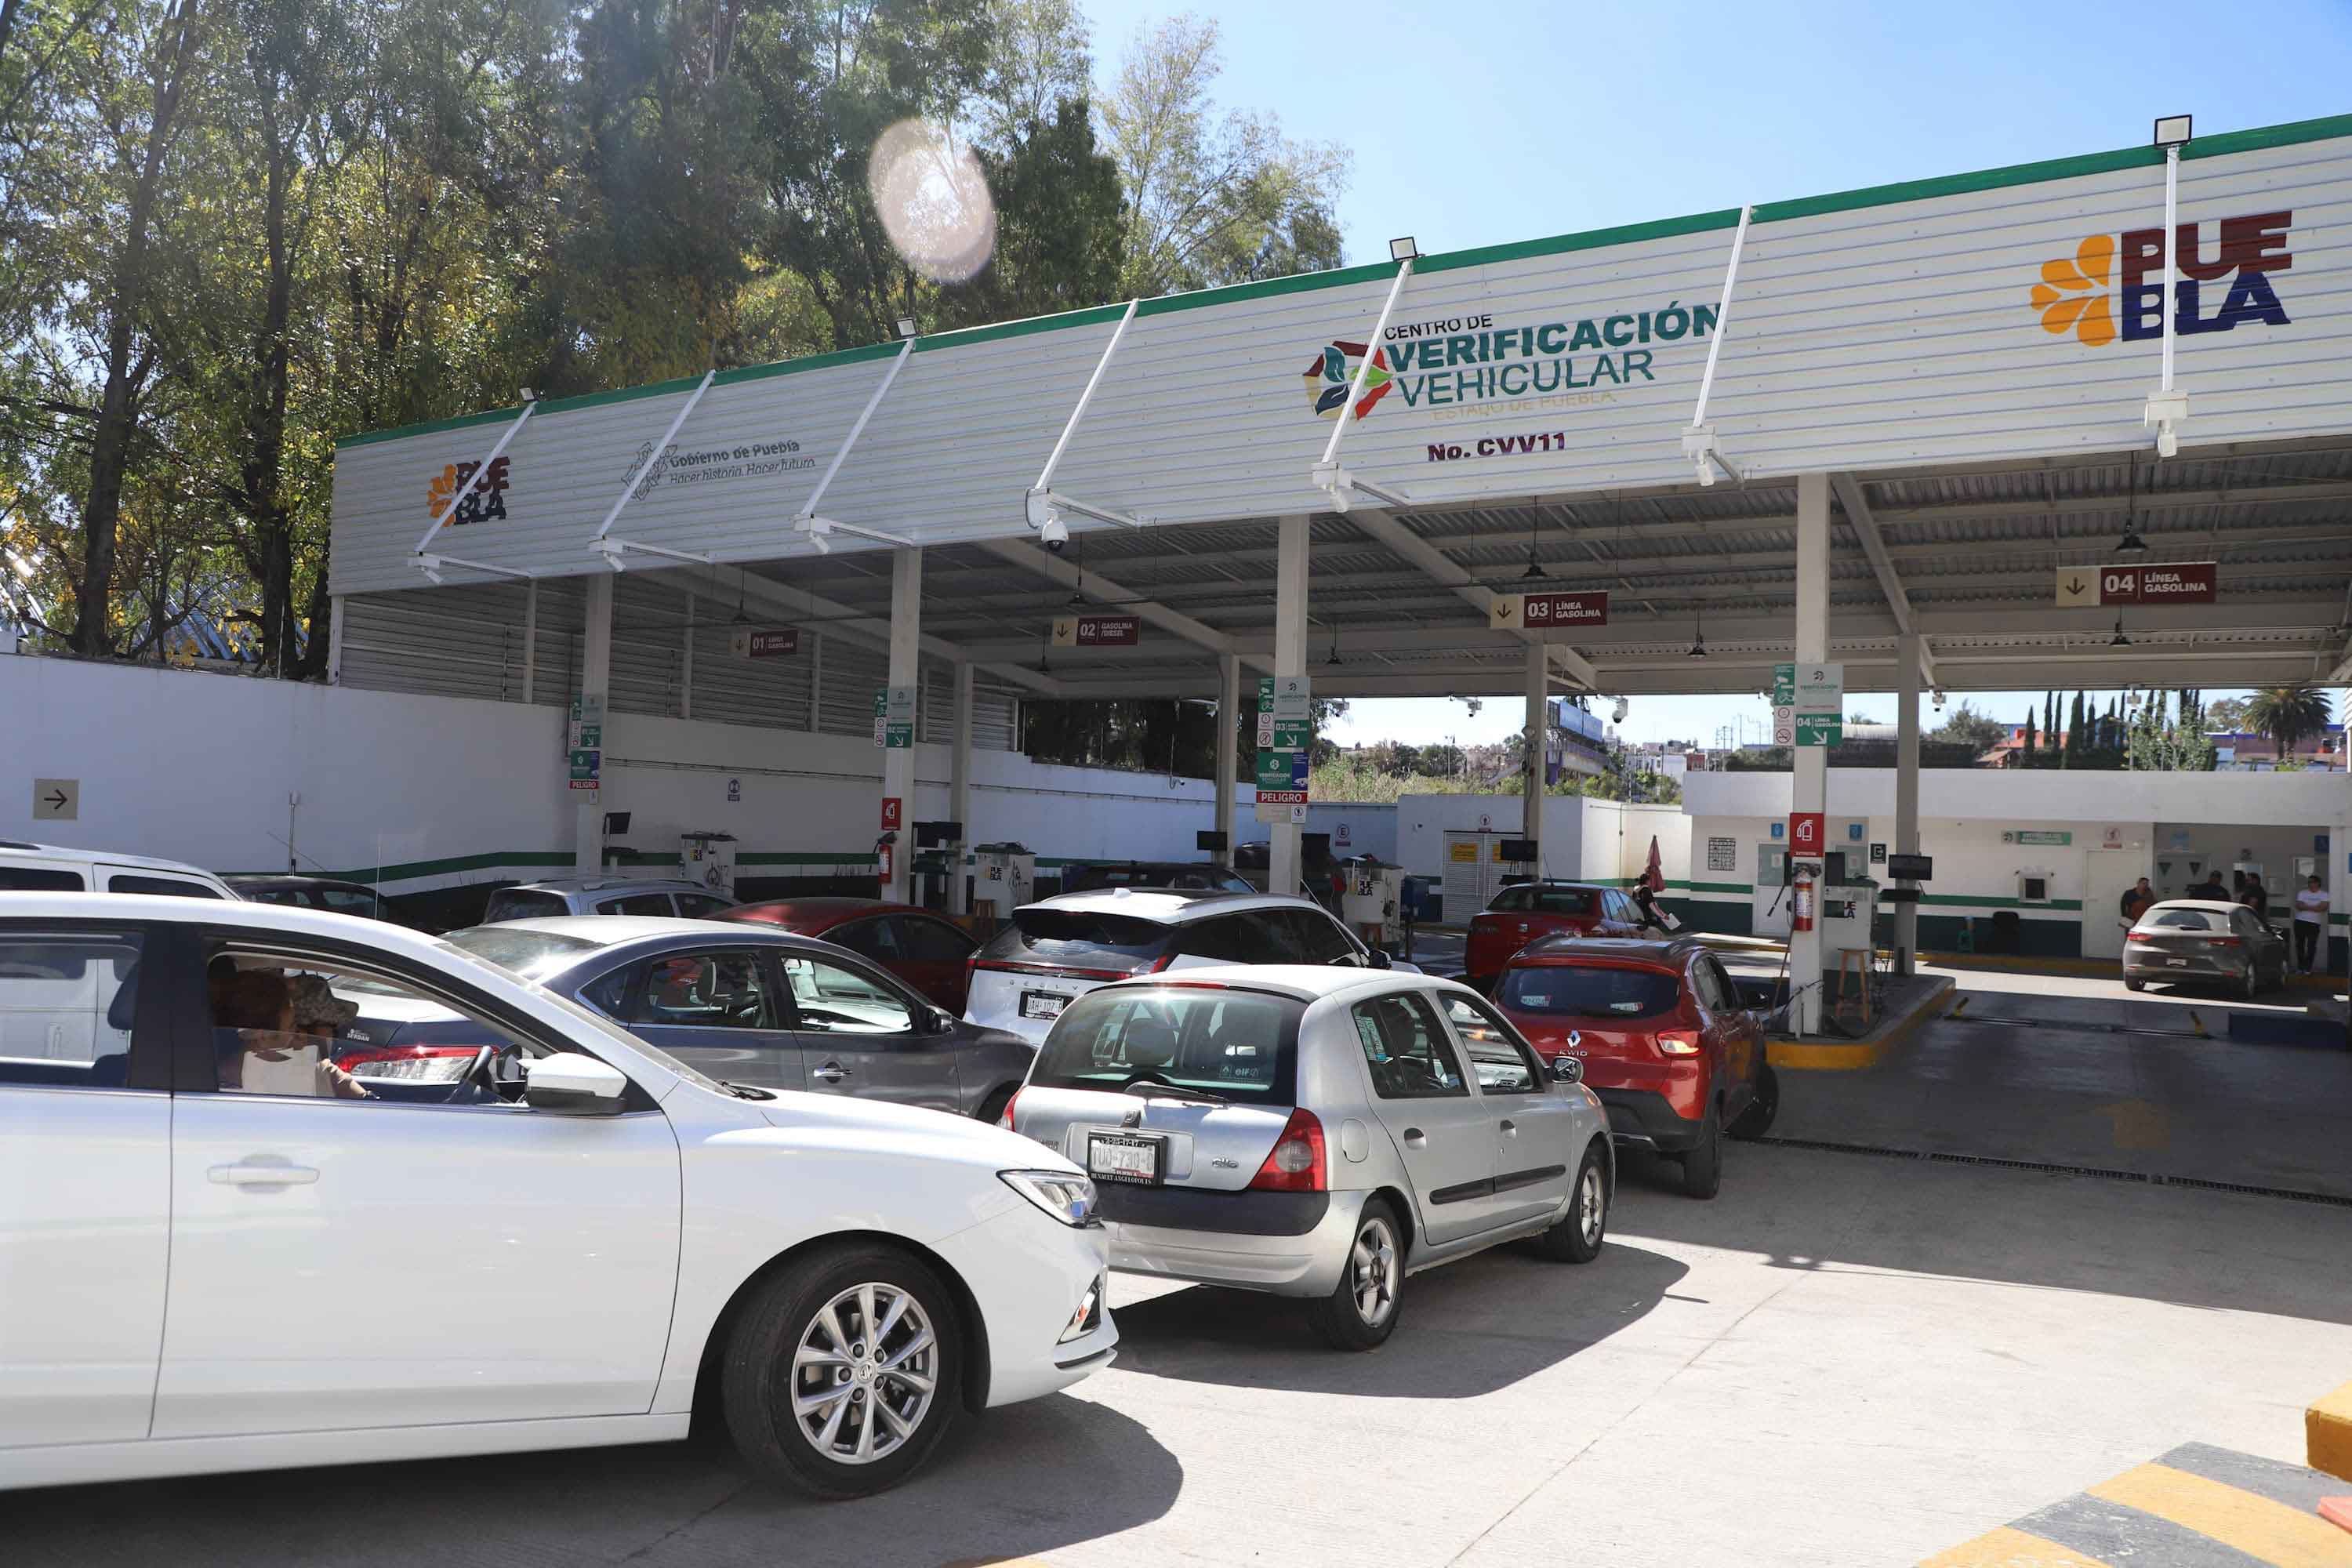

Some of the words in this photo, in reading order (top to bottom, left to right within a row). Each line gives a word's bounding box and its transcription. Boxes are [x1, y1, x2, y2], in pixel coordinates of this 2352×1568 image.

[2122, 210, 2292, 285] PUE
[2122, 271, 2292, 342] BLA
[1385, 318, 1461, 341] CENTRO
[1467, 314, 1493, 330] DE
[1385, 301, 1726, 373] VERIFICACIÓN
[1397, 348, 1655, 408] VEHICULAR
[670, 449, 729, 469] Gobierno
[733, 445, 750, 459] de
[752, 439, 801, 458] Puebla
[1428, 441, 1471, 463] No.
[1477, 432, 1566, 456] CVV11
[456, 456, 510, 494] PUE
[455, 489, 507, 526] BLA
[2104, 575, 2134, 593] 04
[2145, 573, 2180, 583] LÍNEA
[2145, 583, 2207, 593] GASOLINA
[1528, 602, 1548, 617] 03
[1556, 601, 1582, 610] LÍNEA
[1555, 609, 1601, 619] GASOLINA
[1080, 623, 1096, 637] 02
[753, 637, 765, 649] 01
[1797, 717, 1811, 728] 04
[572, 781, 597, 789] PELIGRO
[1261, 793, 1302, 803] PELIGRO
[1235, 1067, 1250, 1077] elf
[1091, 1172, 1114, 1181] RENAULT
